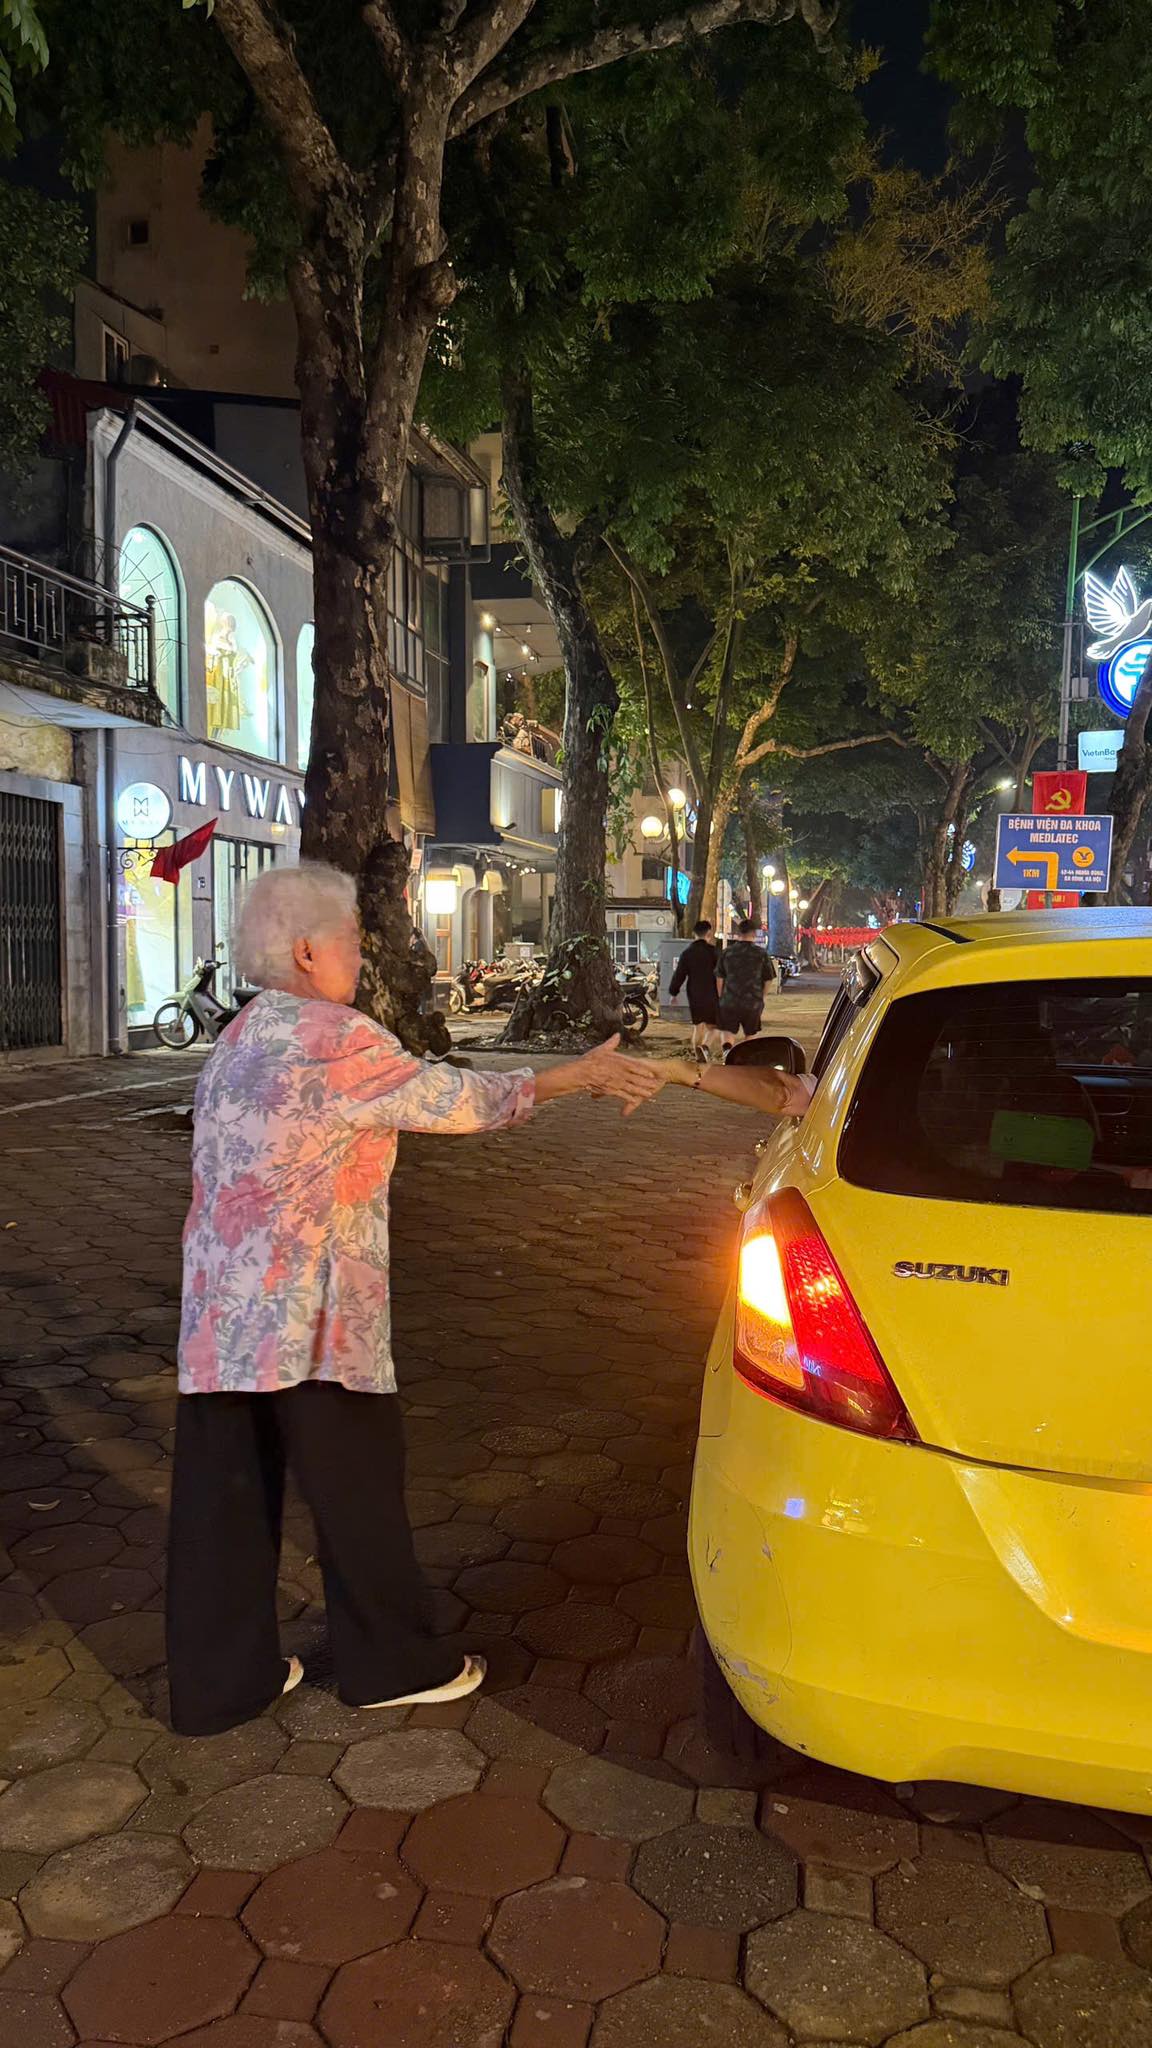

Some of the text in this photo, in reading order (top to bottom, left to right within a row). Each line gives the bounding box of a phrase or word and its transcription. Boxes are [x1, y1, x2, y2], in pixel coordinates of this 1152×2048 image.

[1081, 748, 1116, 757] VietinBa
[1008, 817, 1101, 832] BỆNH VIỆN ĐA KHOA
[1029, 832, 1079, 844] MEDLATEC
[893, 1261, 1010, 1287] SUZUKI
